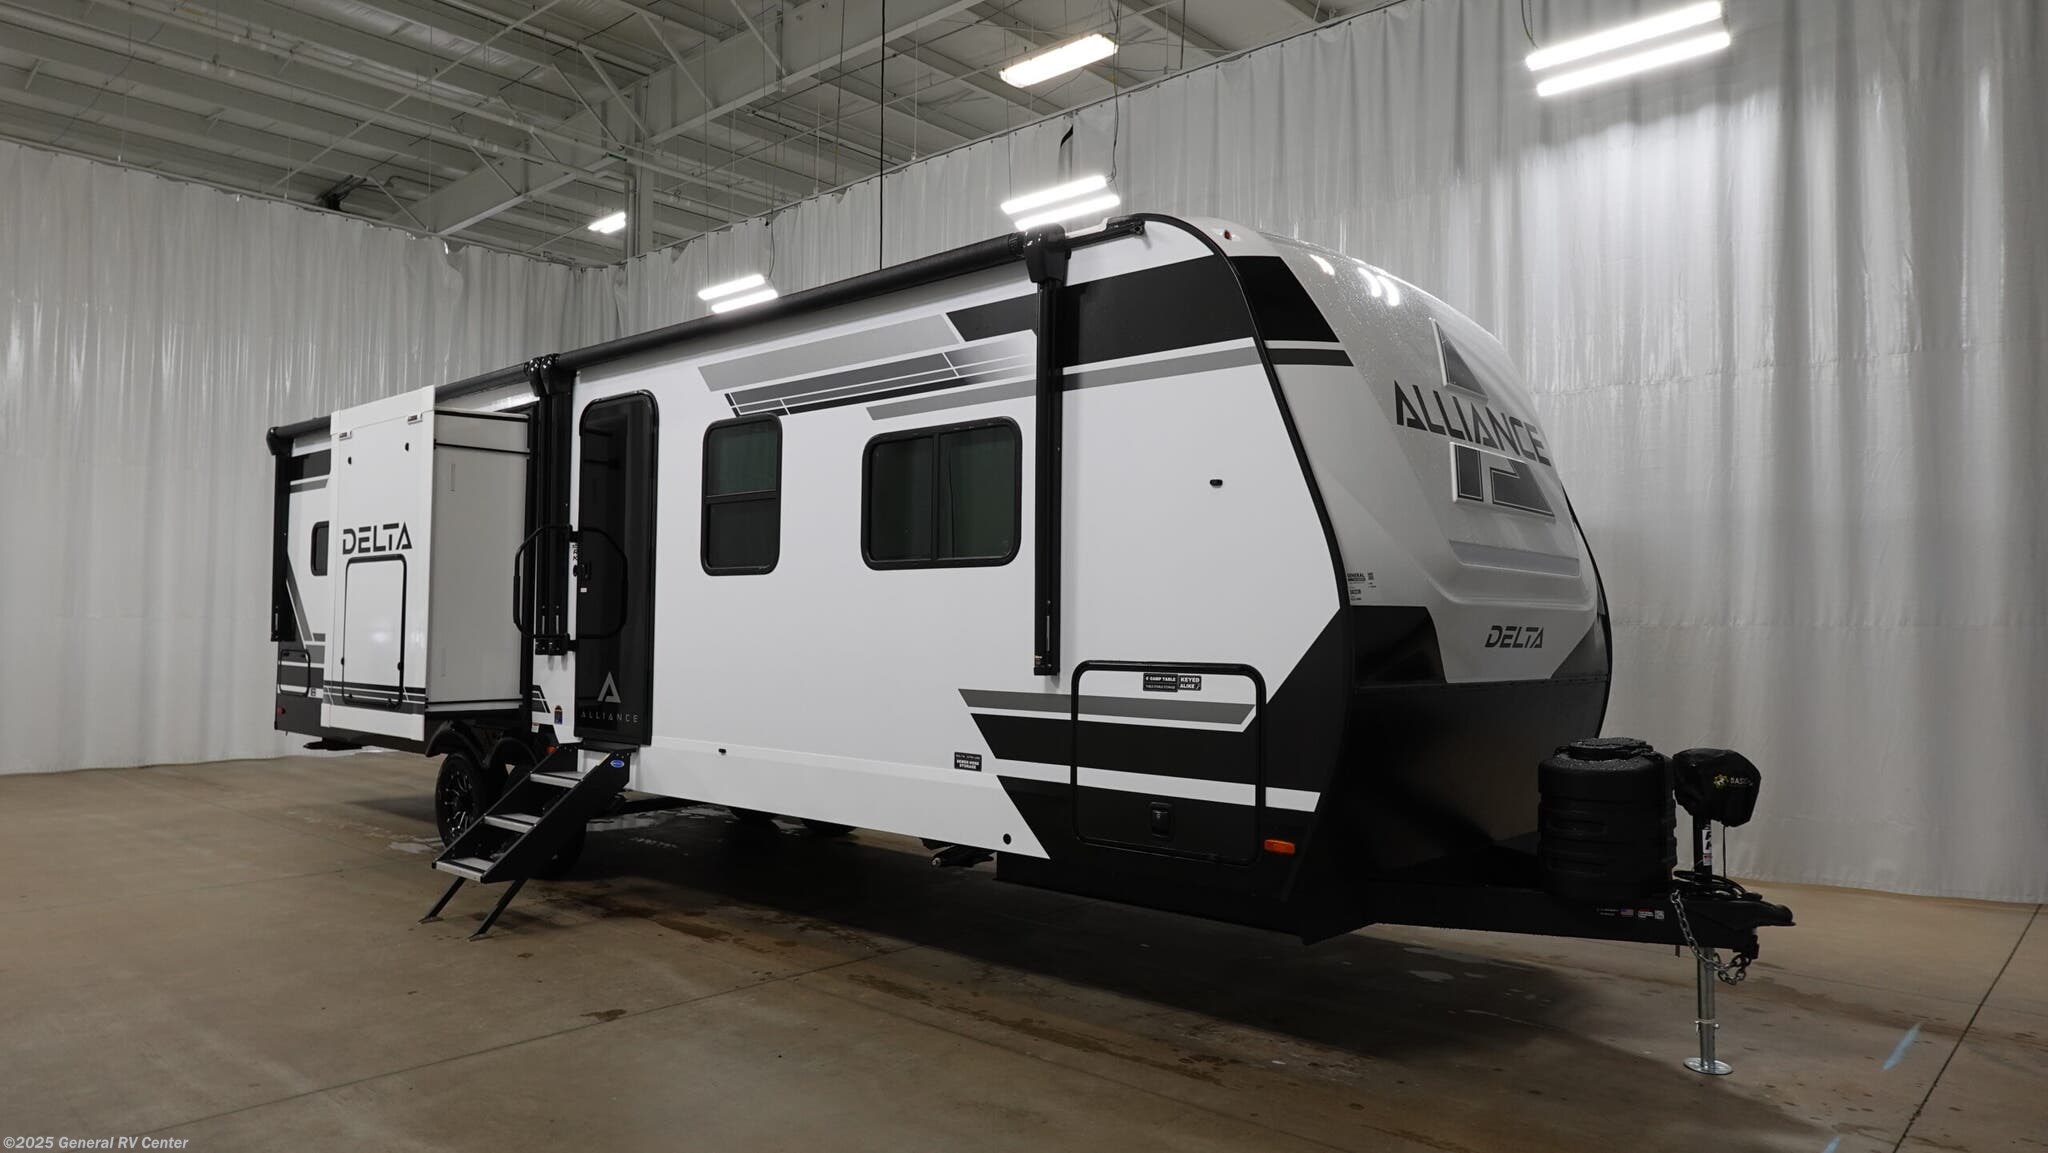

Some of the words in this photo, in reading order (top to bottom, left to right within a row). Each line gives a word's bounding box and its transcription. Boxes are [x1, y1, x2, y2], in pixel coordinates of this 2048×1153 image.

[1393, 380, 1552, 467] ALLIANCE
[342, 521, 413, 556] DELTA
[1484, 624, 1544, 649] DELTA
[580, 711, 639, 723] ALLIANCE
